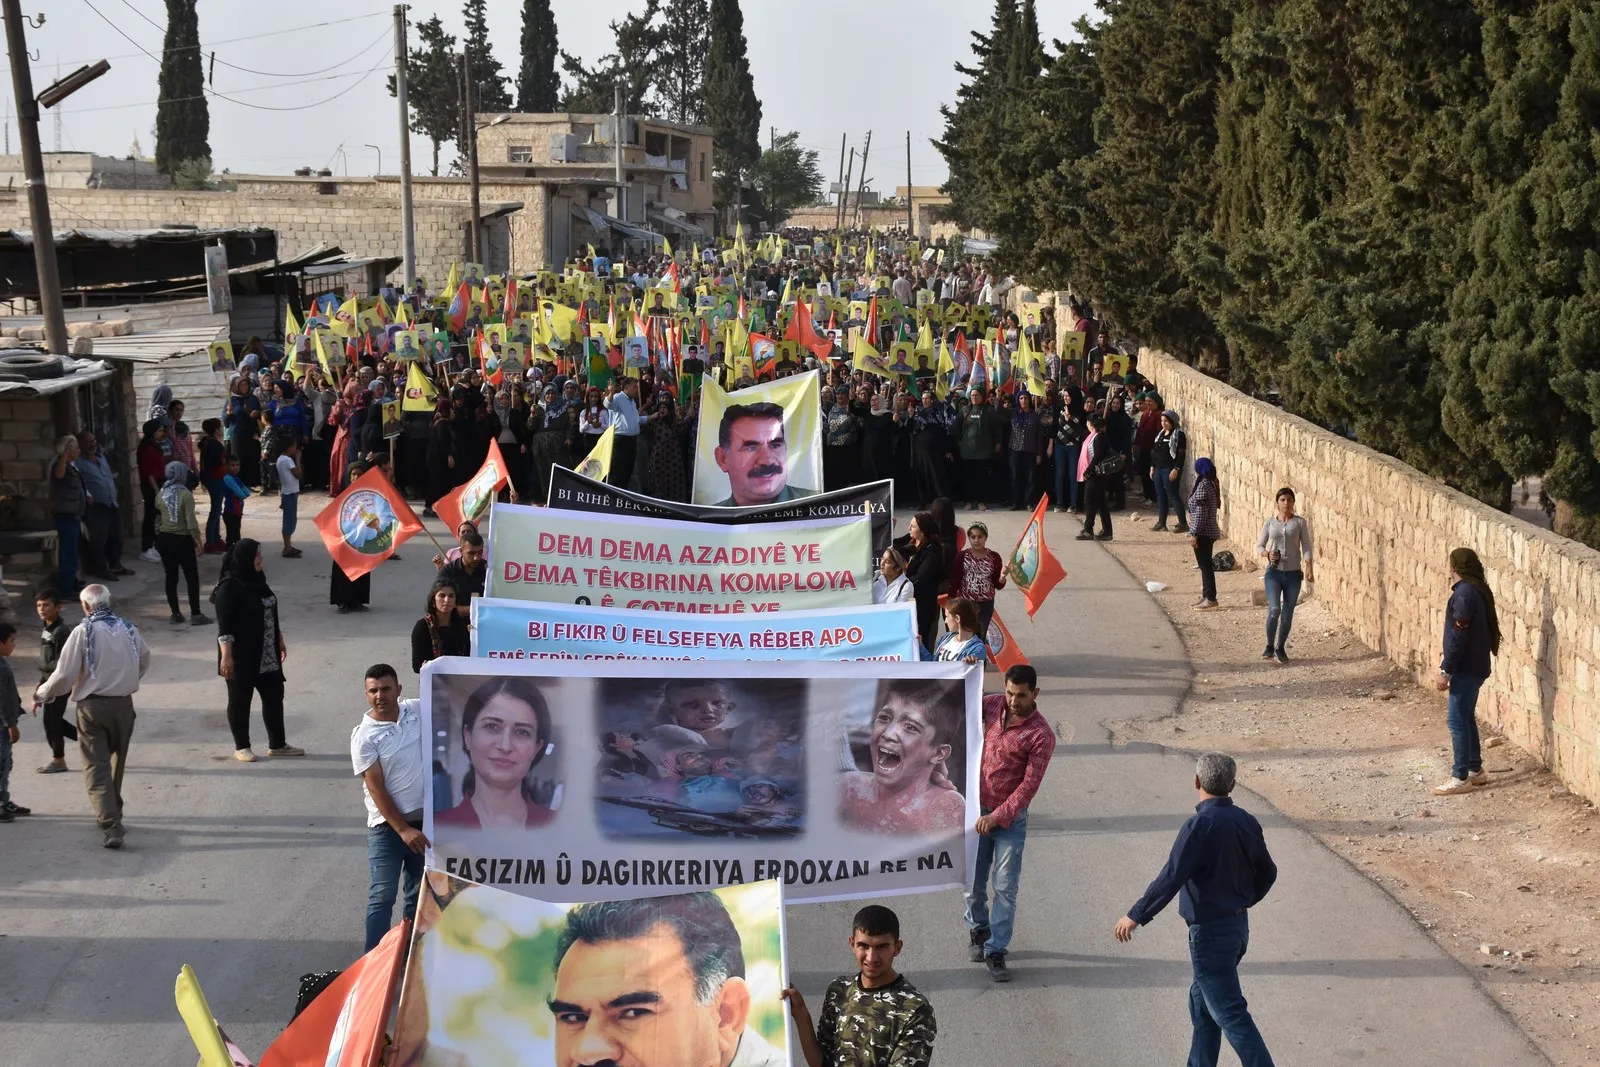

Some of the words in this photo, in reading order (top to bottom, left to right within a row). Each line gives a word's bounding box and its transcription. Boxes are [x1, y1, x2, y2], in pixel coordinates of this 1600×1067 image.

[558, 488, 571, 500] BI
[577, 491, 610, 507] RIHÊ
[809, 503, 886, 516] KOMPLOYA
[538, 532, 594, 557] DEM
[600, 538, 672, 563] DEMA
[678, 541, 786, 565] AZADIYÊ
[791, 543, 822, 563] YE
[504, 561, 578, 585] DEMA
[583, 565, 713, 593] TÊKBIRINA
[720, 570, 857, 593] KOMPLOYA
[528, 621, 548, 638] BI
[553, 623, 606, 640] FIKIR
[612, 623, 626, 642] Û
[632, 627, 744, 648] FELSEFEYA
[750, 629, 814, 648] RÊBER
[819, 626, 863, 646] APO
[446, 857, 546, 884] FASIZIM
[556, 852, 571, 885] Û
[582, 859, 744, 886] DAGIRKERIYA
[753, 859, 870, 885] ERDOXAN
[879, 859, 907, 874] RE
[917, 851, 954, 870] NA
